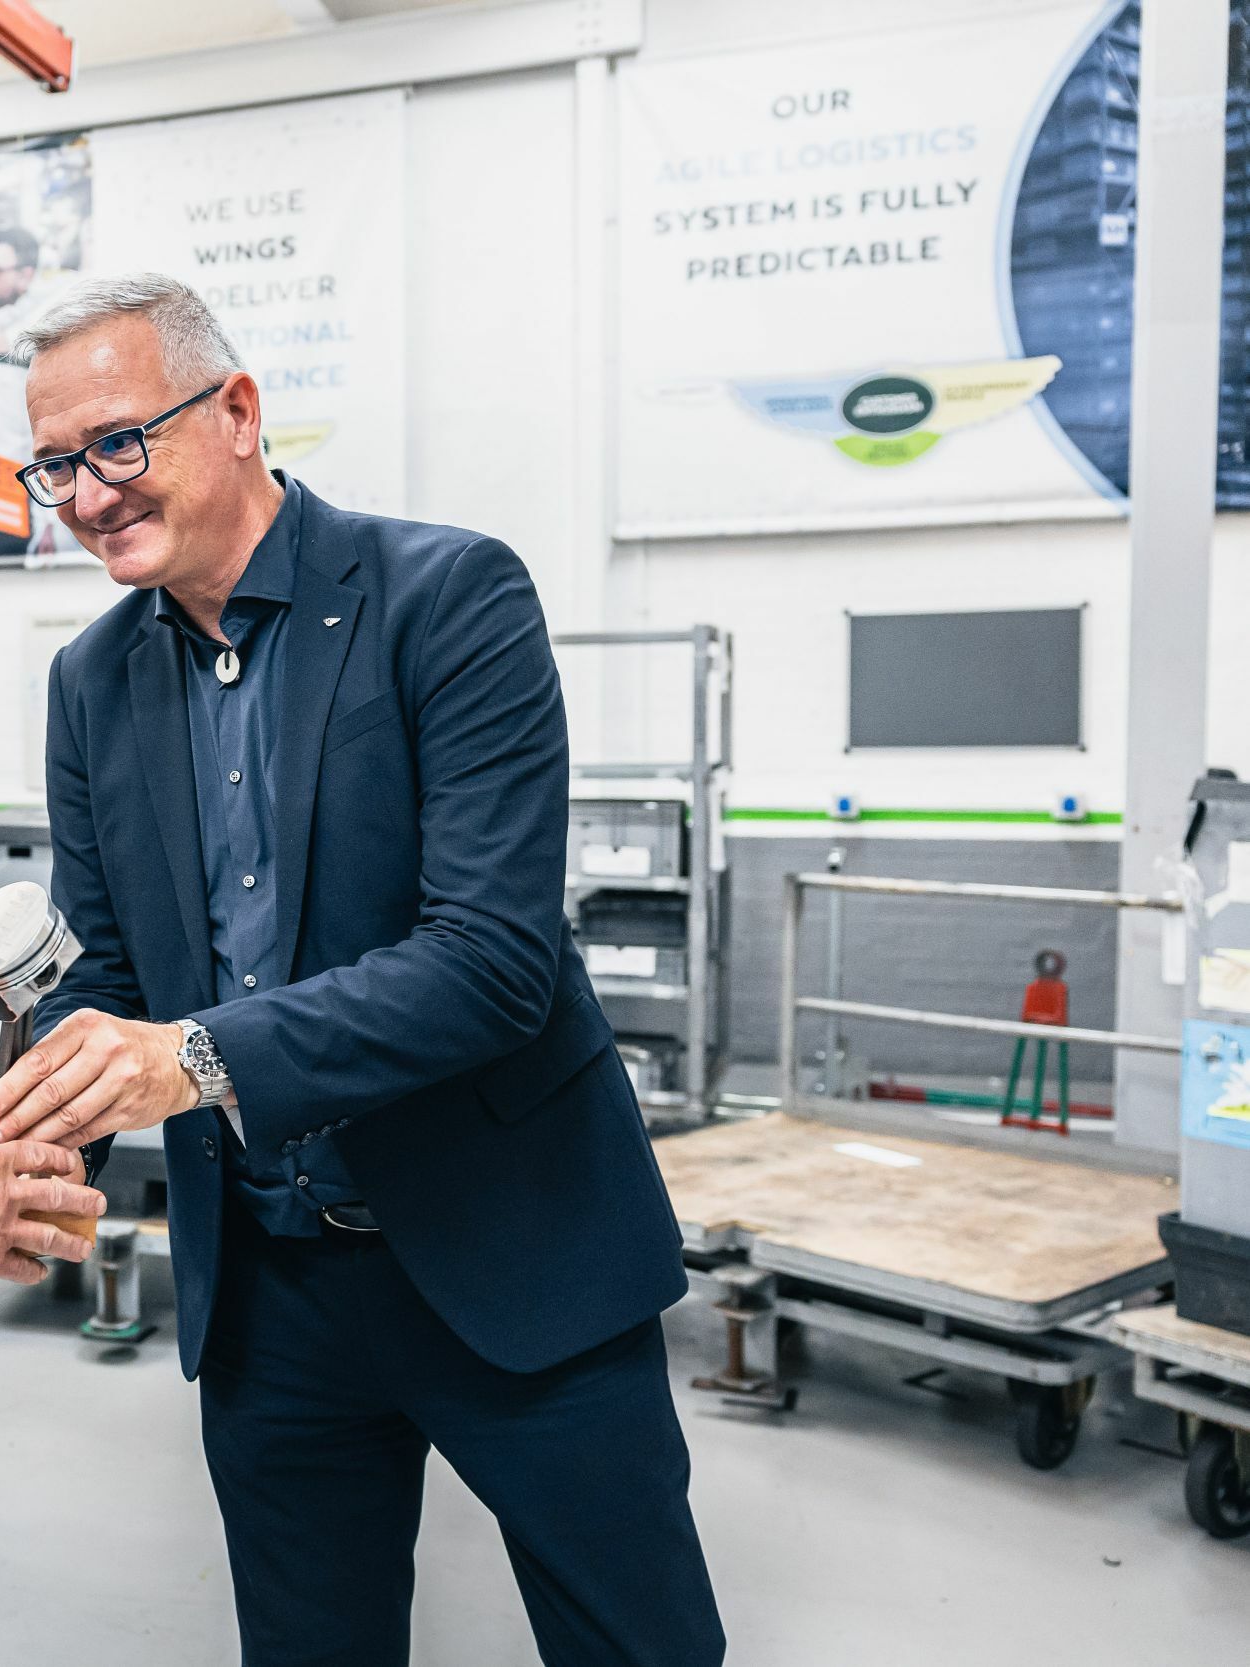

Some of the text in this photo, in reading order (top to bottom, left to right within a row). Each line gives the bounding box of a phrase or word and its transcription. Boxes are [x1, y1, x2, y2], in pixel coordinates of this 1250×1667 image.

[771, 89, 851, 120] OUR
[656, 123, 978, 184] AGILE LOGISTICS
[184, 188, 304, 222] WE USE
[654, 177, 979, 236] SYSTEM IS FULLY
[193, 235, 297, 265] WINGS
[686, 236, 942, 282] PREDICTABLE
[204, 274, 338, 310] DELIVER
[262, 362, 346, 393] ENCE
